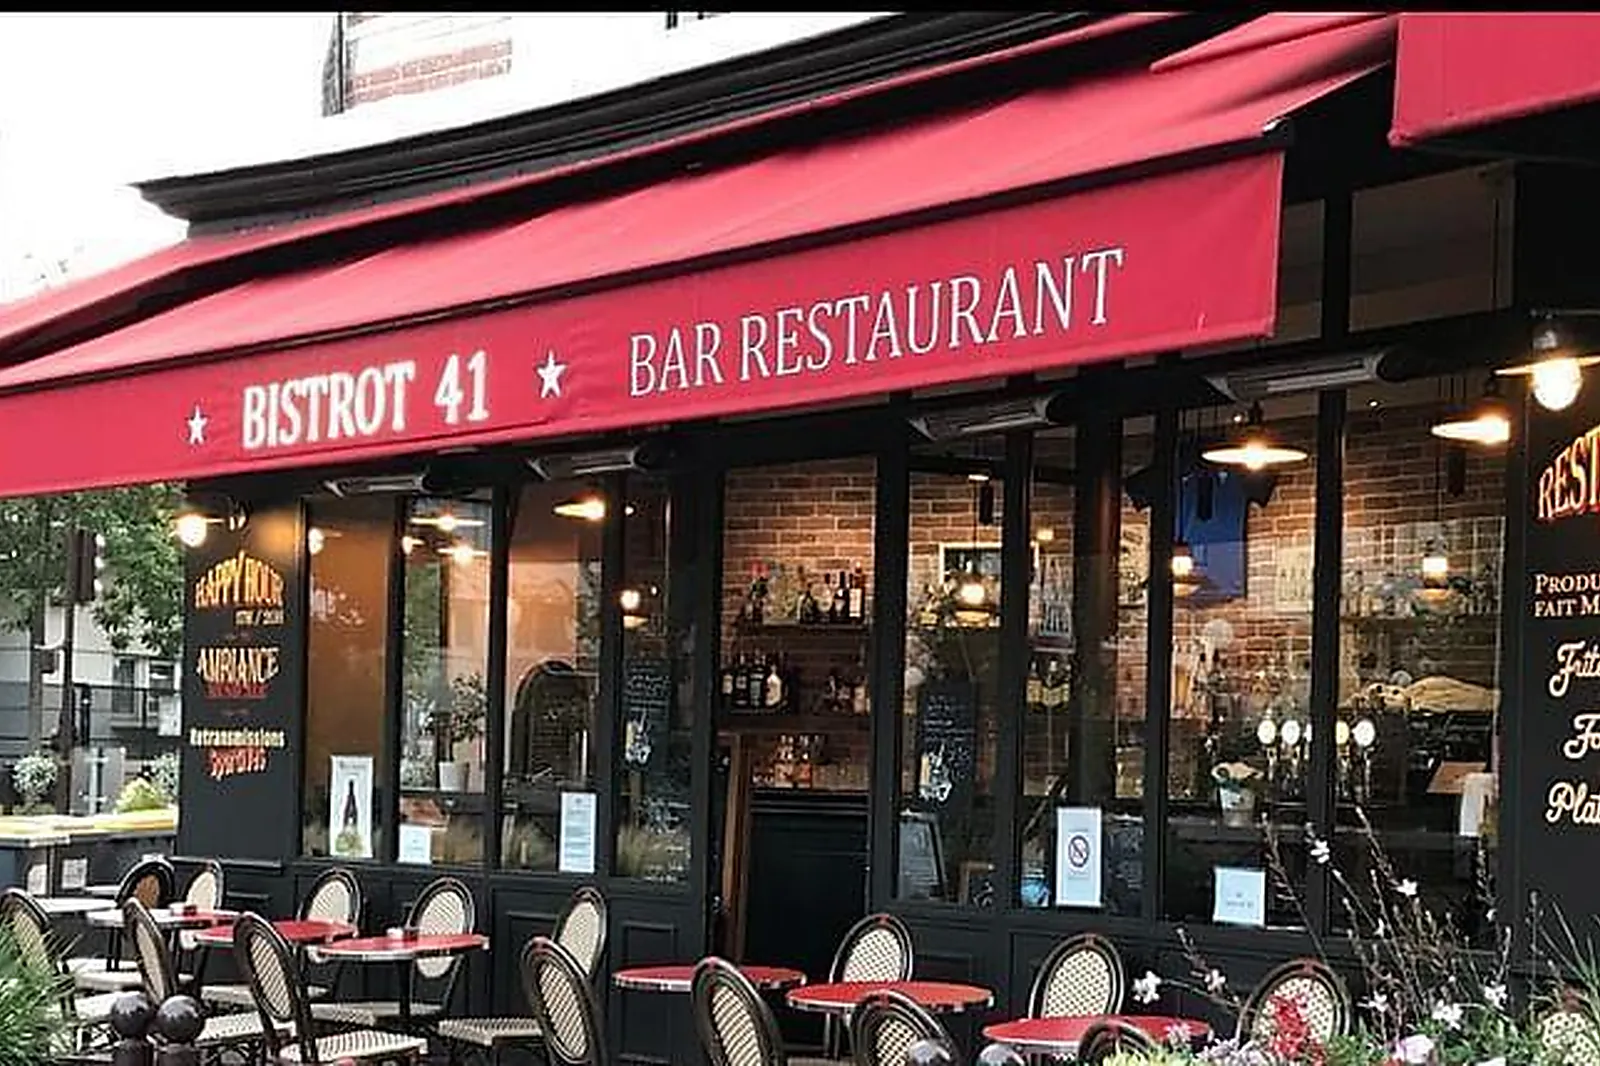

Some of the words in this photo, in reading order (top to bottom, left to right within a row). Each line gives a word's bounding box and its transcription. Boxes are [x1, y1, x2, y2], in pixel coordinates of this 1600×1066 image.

[629, 321, 724, 398] BAR
[739, 247, 1125, 382] RESTAURANT
[242, 360, 416, 450] BISTROT
[434, 350, 490, 423] 41
[195, 550, 244, 608] HAPPY
[244, 557, 284, 606] HOUR
[1534, 598, 1577, 617] FAIT
[196, 647, 280, 688] AMBIANCE
